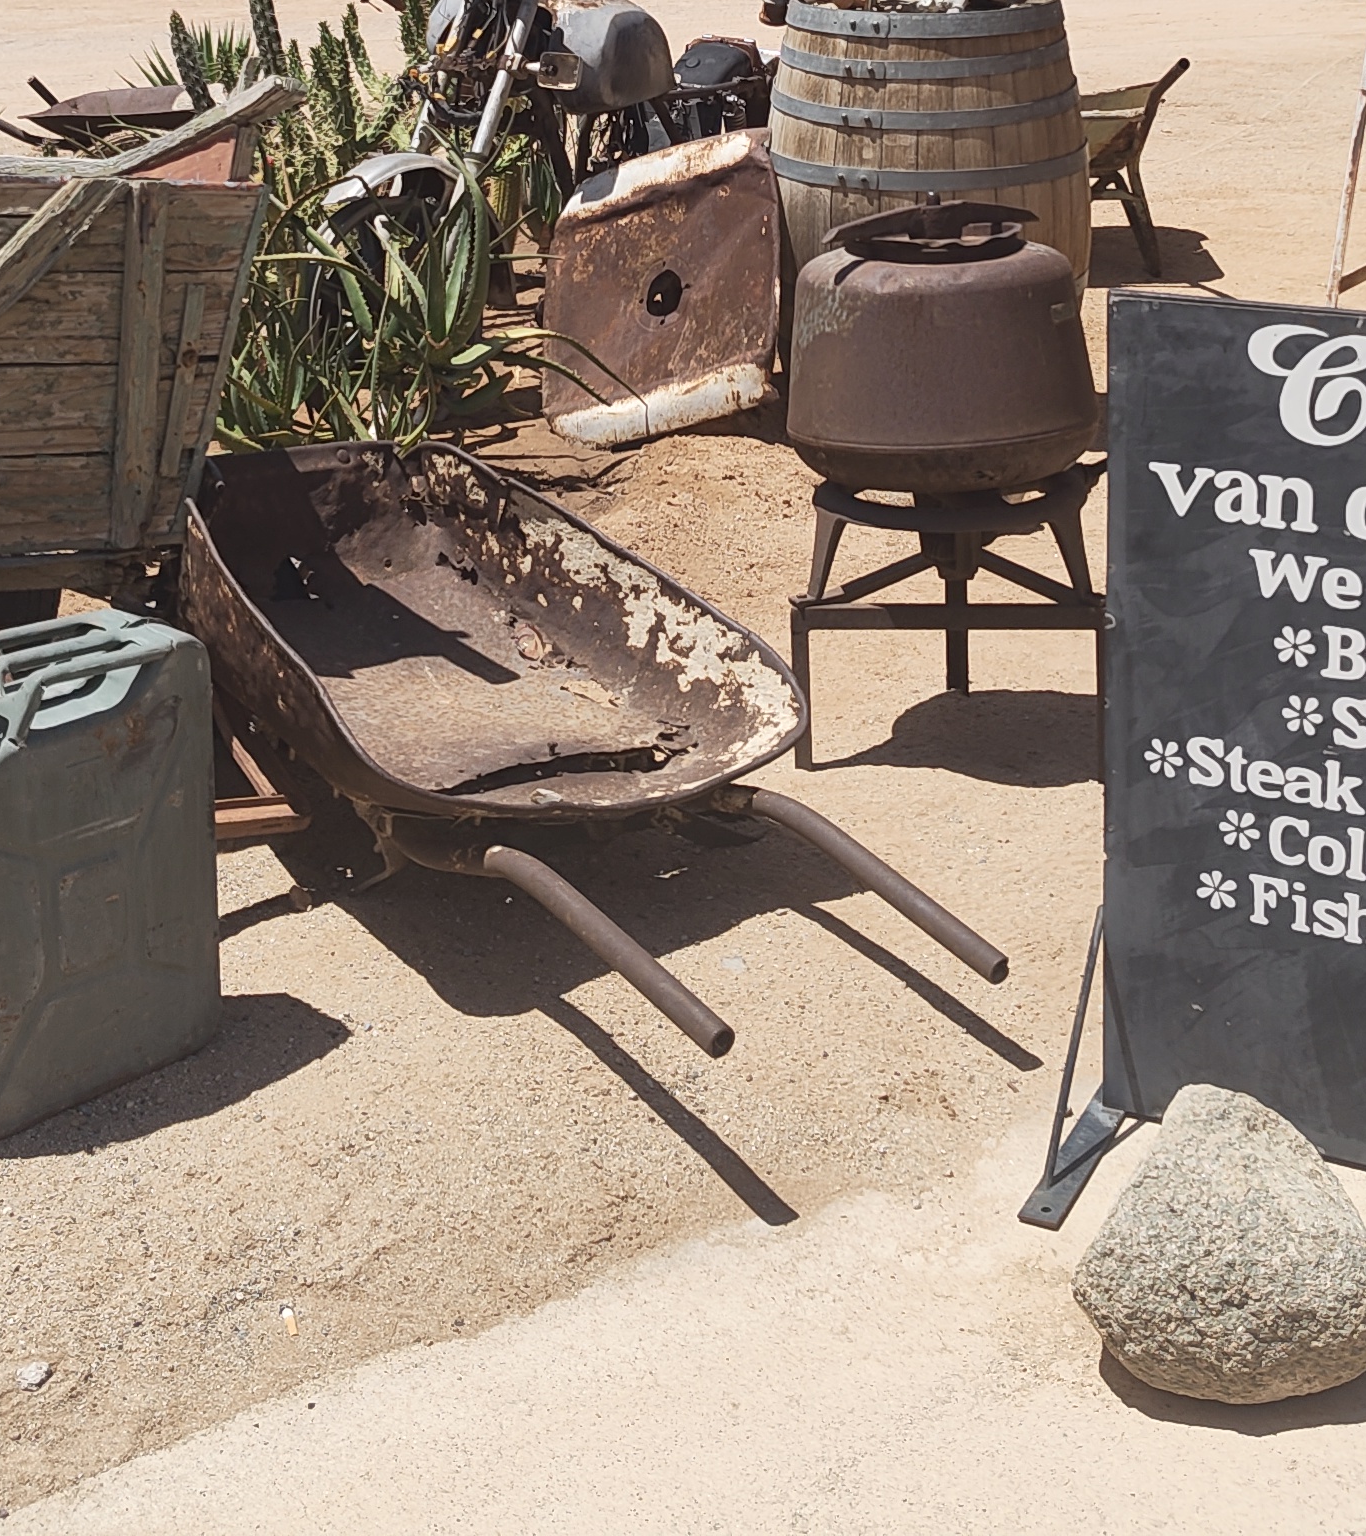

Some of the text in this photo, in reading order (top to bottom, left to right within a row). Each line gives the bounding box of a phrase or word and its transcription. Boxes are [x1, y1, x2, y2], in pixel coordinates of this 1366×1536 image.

[1148, 461, 1319, 533] van
[1248, 547, 1363, 611] We
[1186, 736, 1366, 817] Steak
